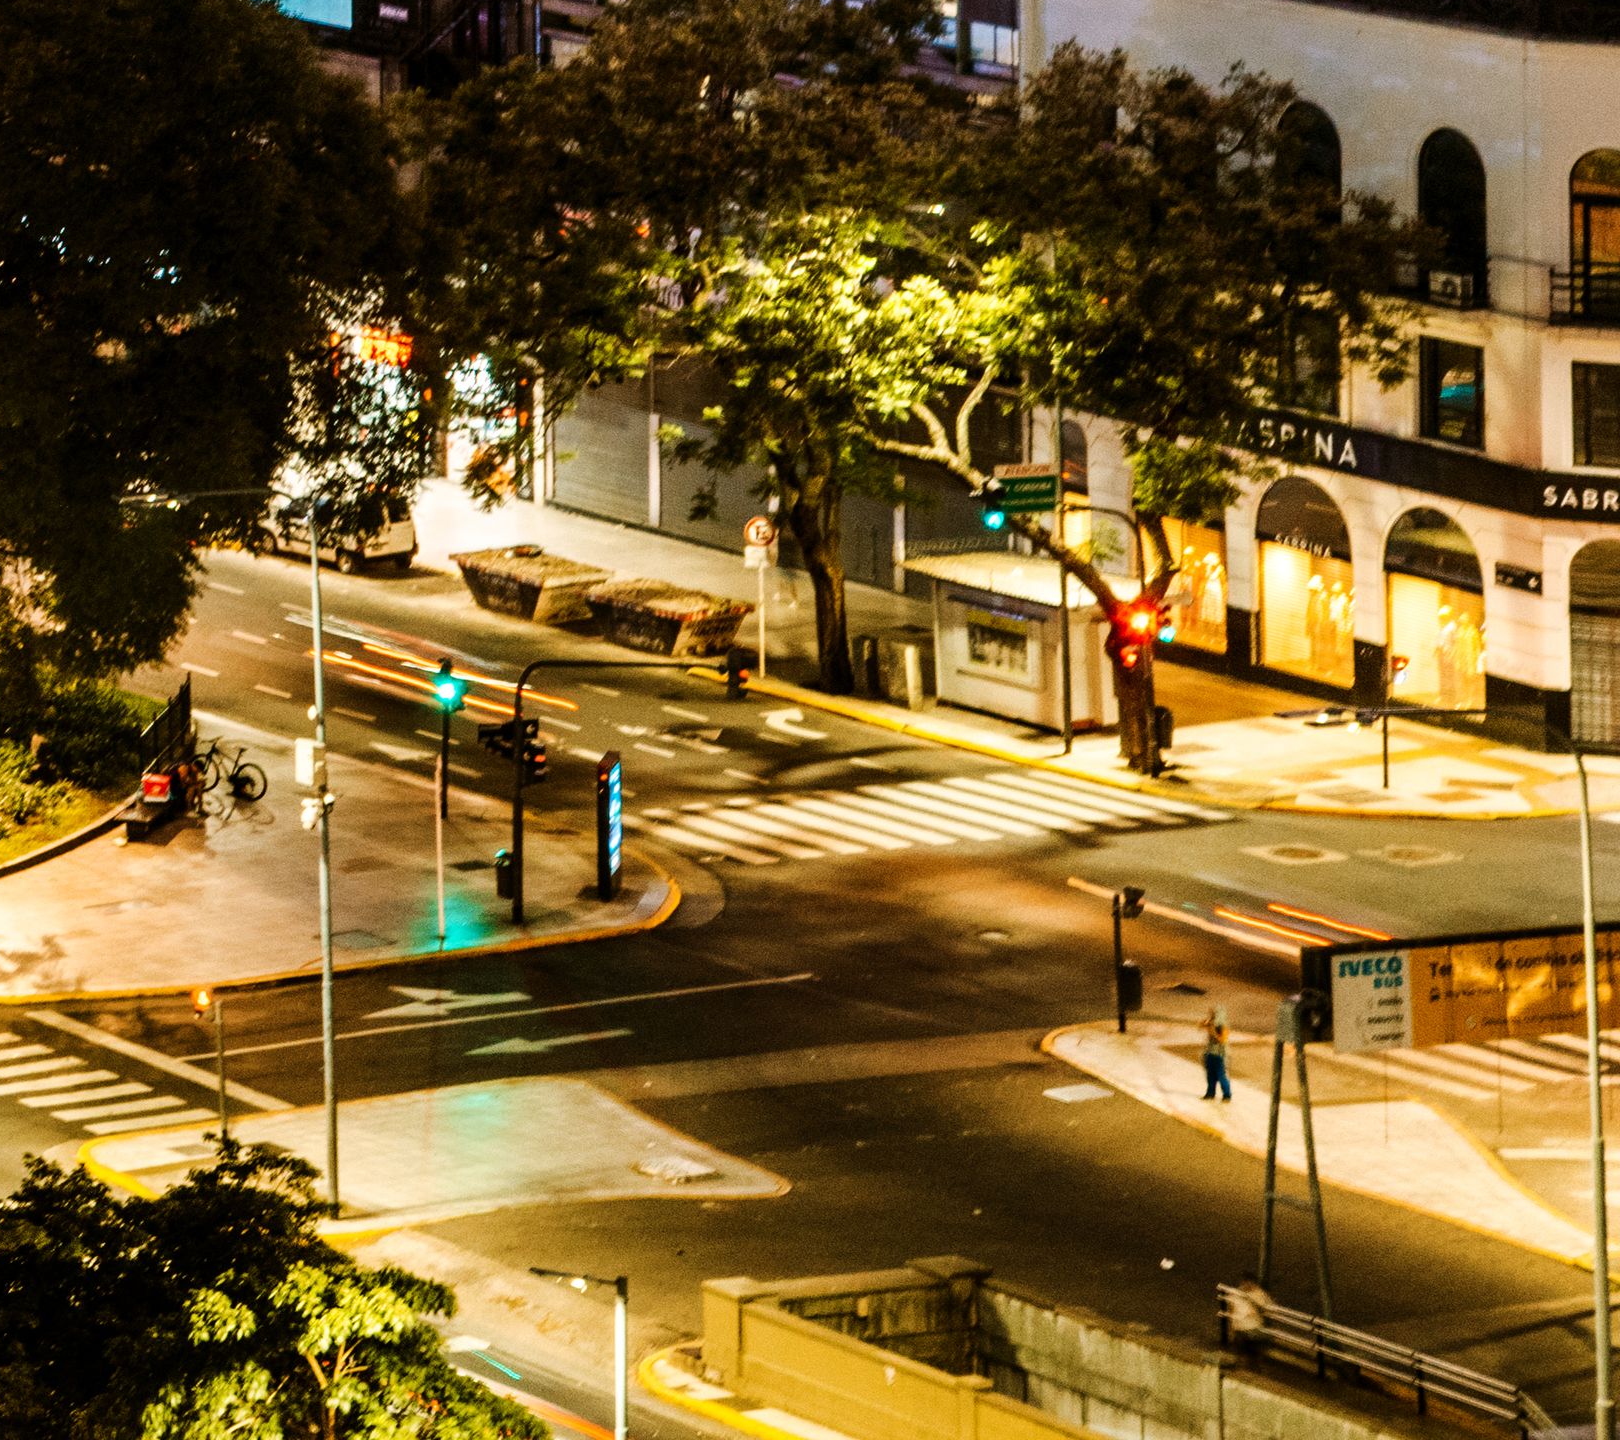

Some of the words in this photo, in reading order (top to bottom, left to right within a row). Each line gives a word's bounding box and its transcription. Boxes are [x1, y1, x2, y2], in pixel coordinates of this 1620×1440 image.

[1274, 531, 1333, 558] SABRINA
[1339, 956, 1404, 979] IVECO
[1373, 975, 1403, 990] BUS
